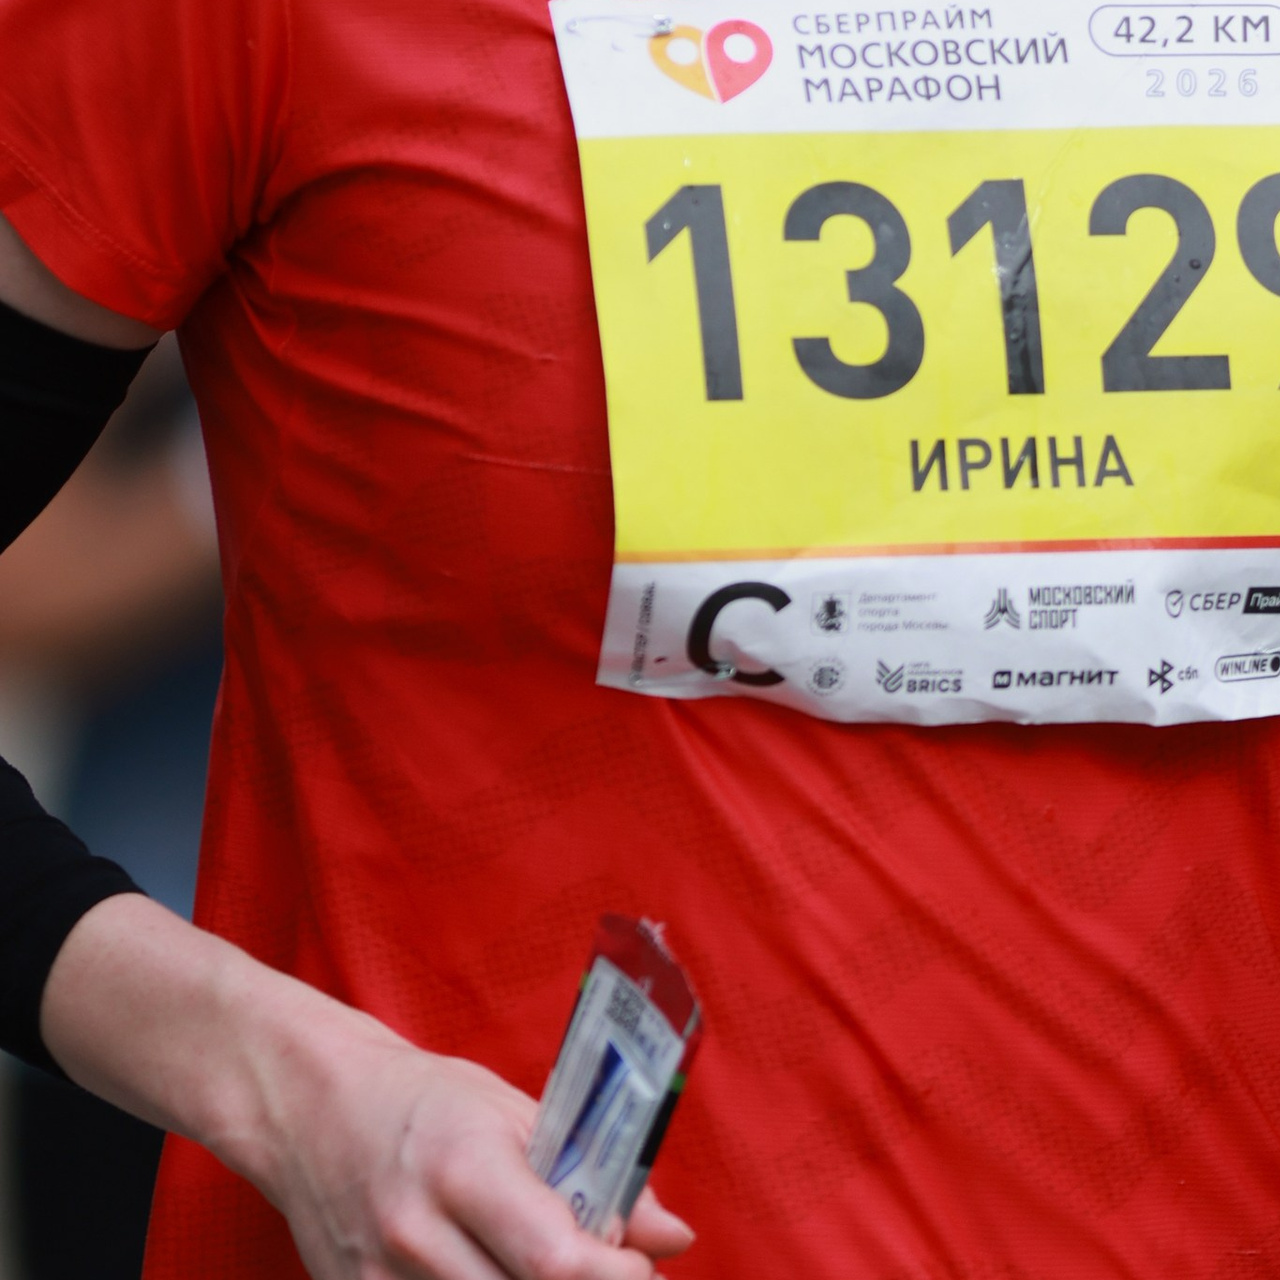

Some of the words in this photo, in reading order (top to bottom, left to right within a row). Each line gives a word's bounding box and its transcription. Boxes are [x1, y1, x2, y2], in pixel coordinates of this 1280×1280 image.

[793, 4, 993, 35] СБЕРПРАЙМ
[1112, 15, 1195, 49] 42,2
[1213, 16, 1271, 44] КМ
[797, 31, 1069, 69] МОСКОВСКИЙ
[804, 74, 1001, 102] МАРАФОН
[1145, 68, 1259, 97] 2026
[909, 434, 1134, 493] ИРИНА
[1028, 580, 1135, 605] МОСКОВСКИЙ
[1189, 592, 1241, 611] СБЕР
[1029, 608, 1078, 630] СПОРТ
[1178, 667, 1199, 681] сбп
[1220, 658, 1268, 676] WINLINE
[907, 679, 962, 693] BRICS
